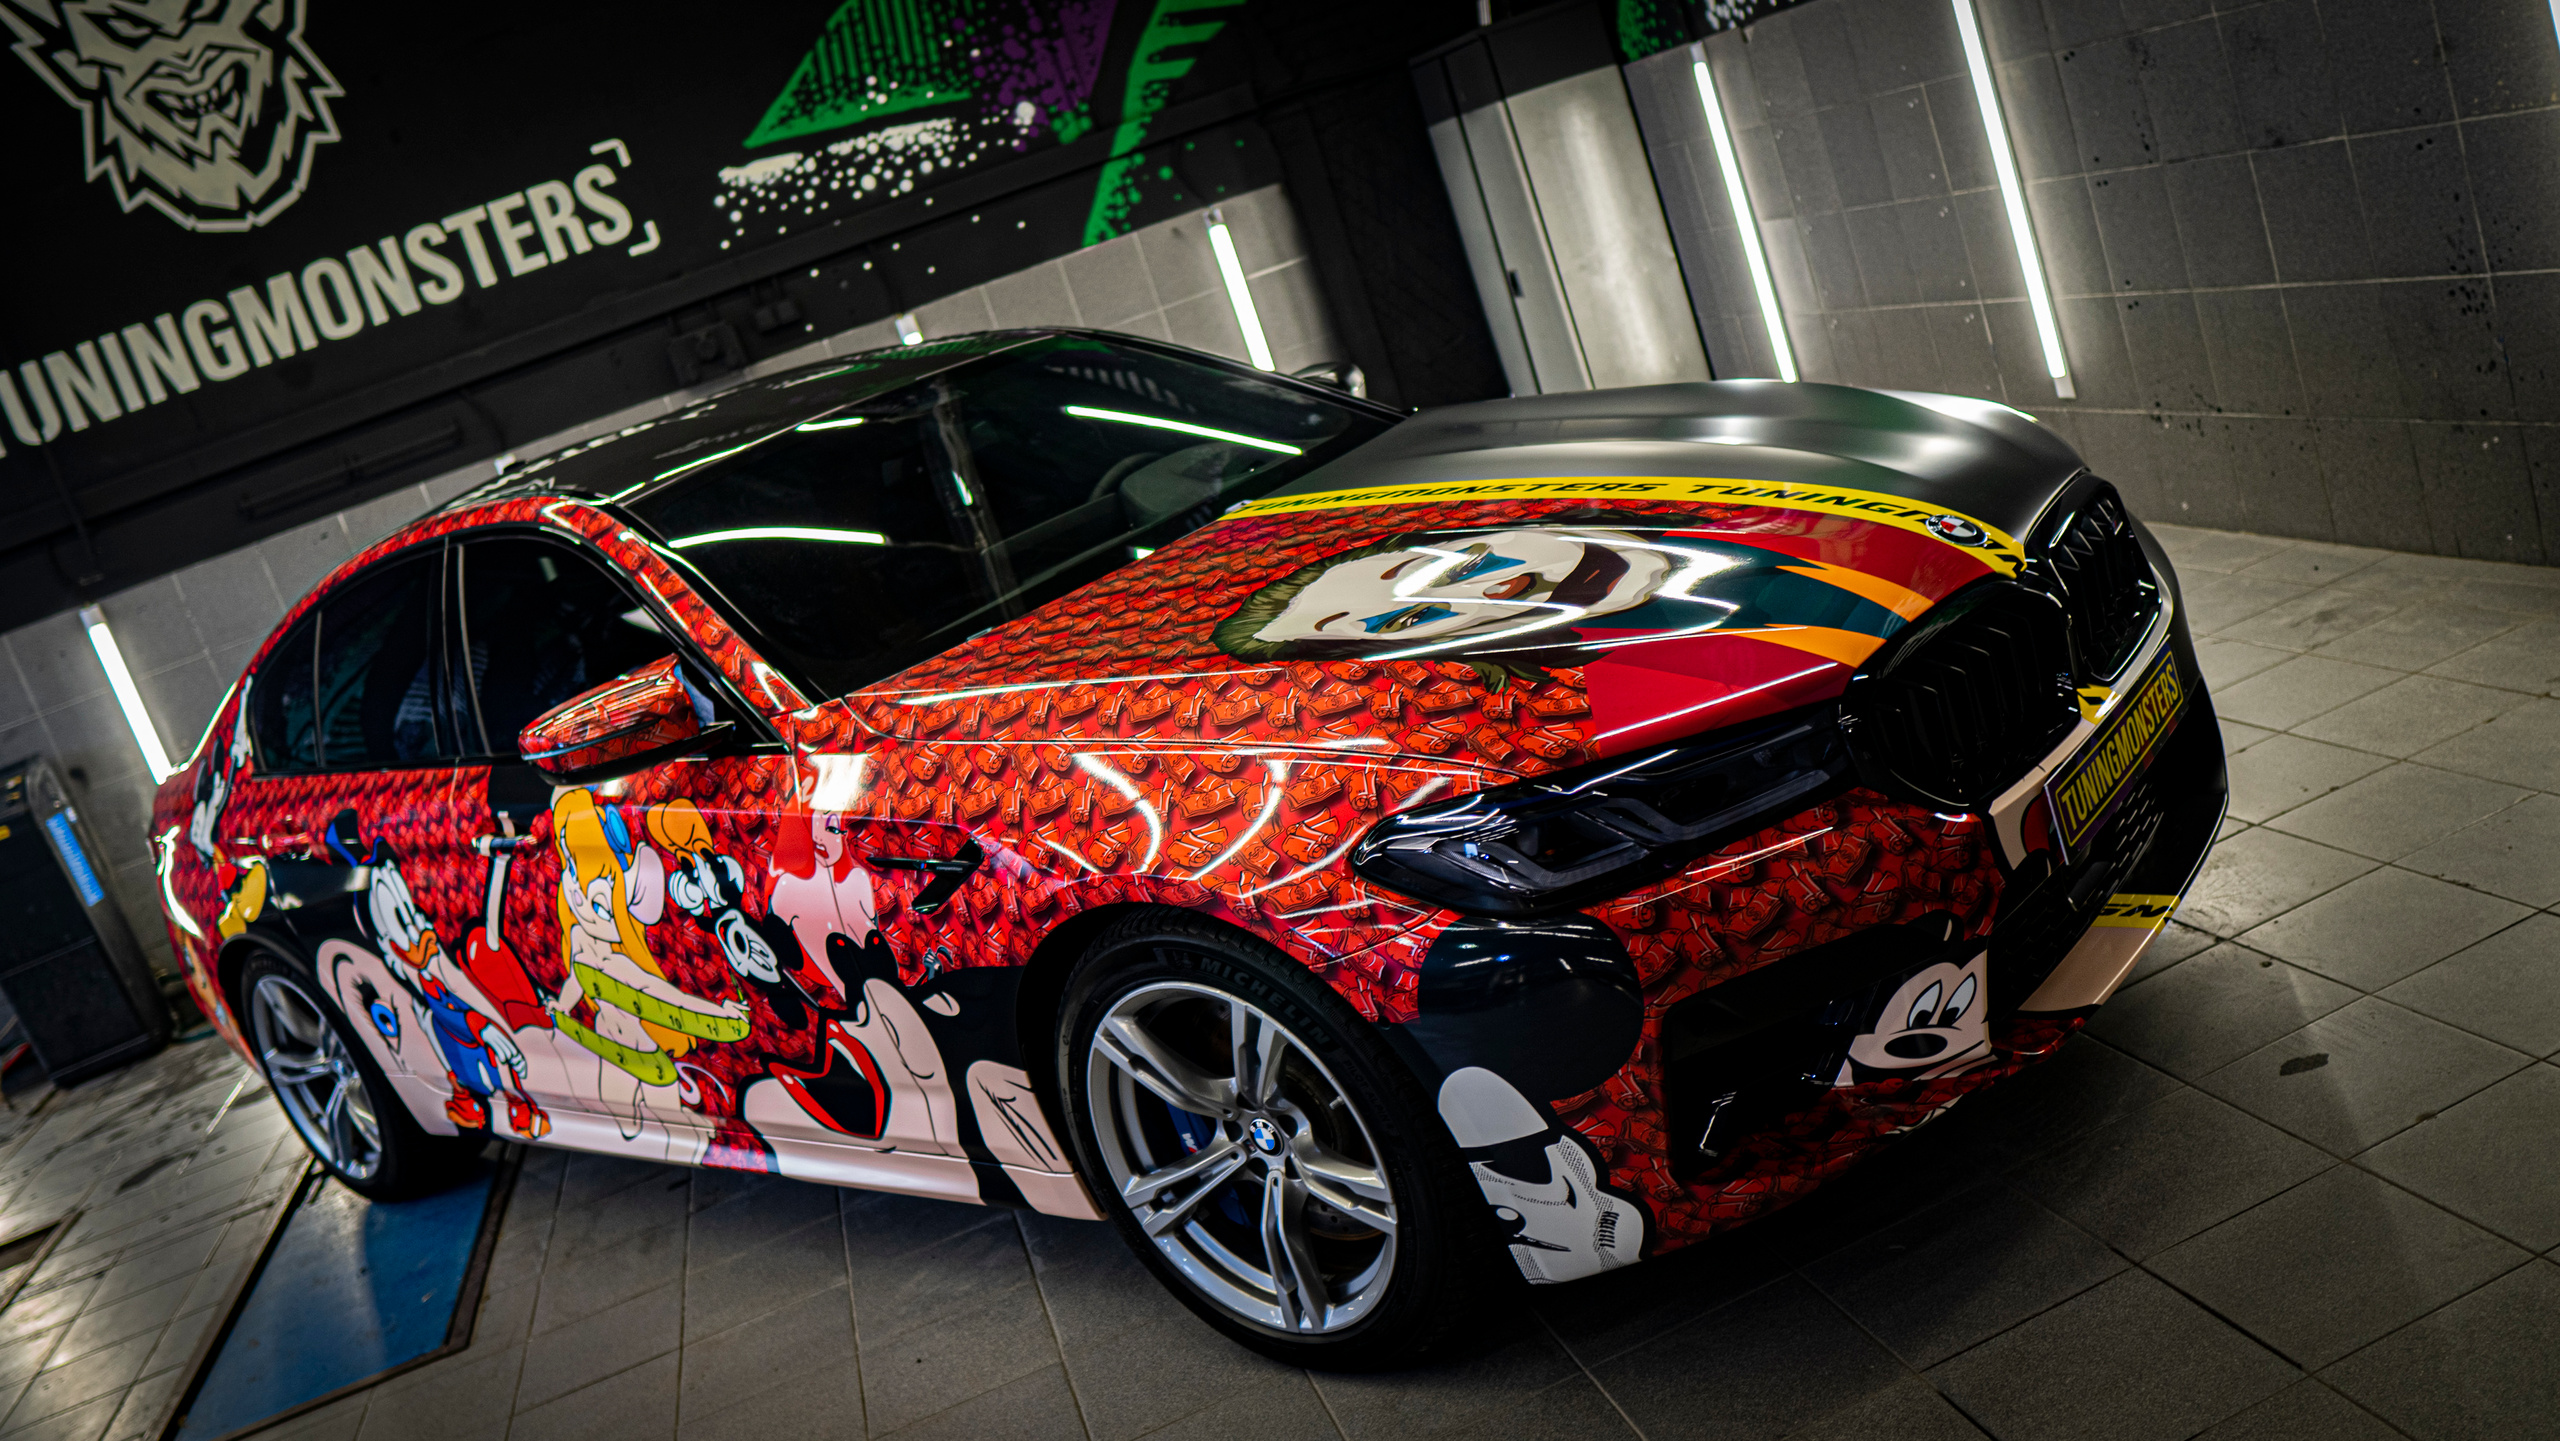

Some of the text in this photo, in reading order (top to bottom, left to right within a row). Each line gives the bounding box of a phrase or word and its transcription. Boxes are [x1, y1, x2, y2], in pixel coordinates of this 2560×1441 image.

[0, 163, 634, 459] UNINGMONSTERS
[2060, 663, 2179, 831] TUNINGMONSTERS
[1200, 956, 1332, 1046] MICHELIN
